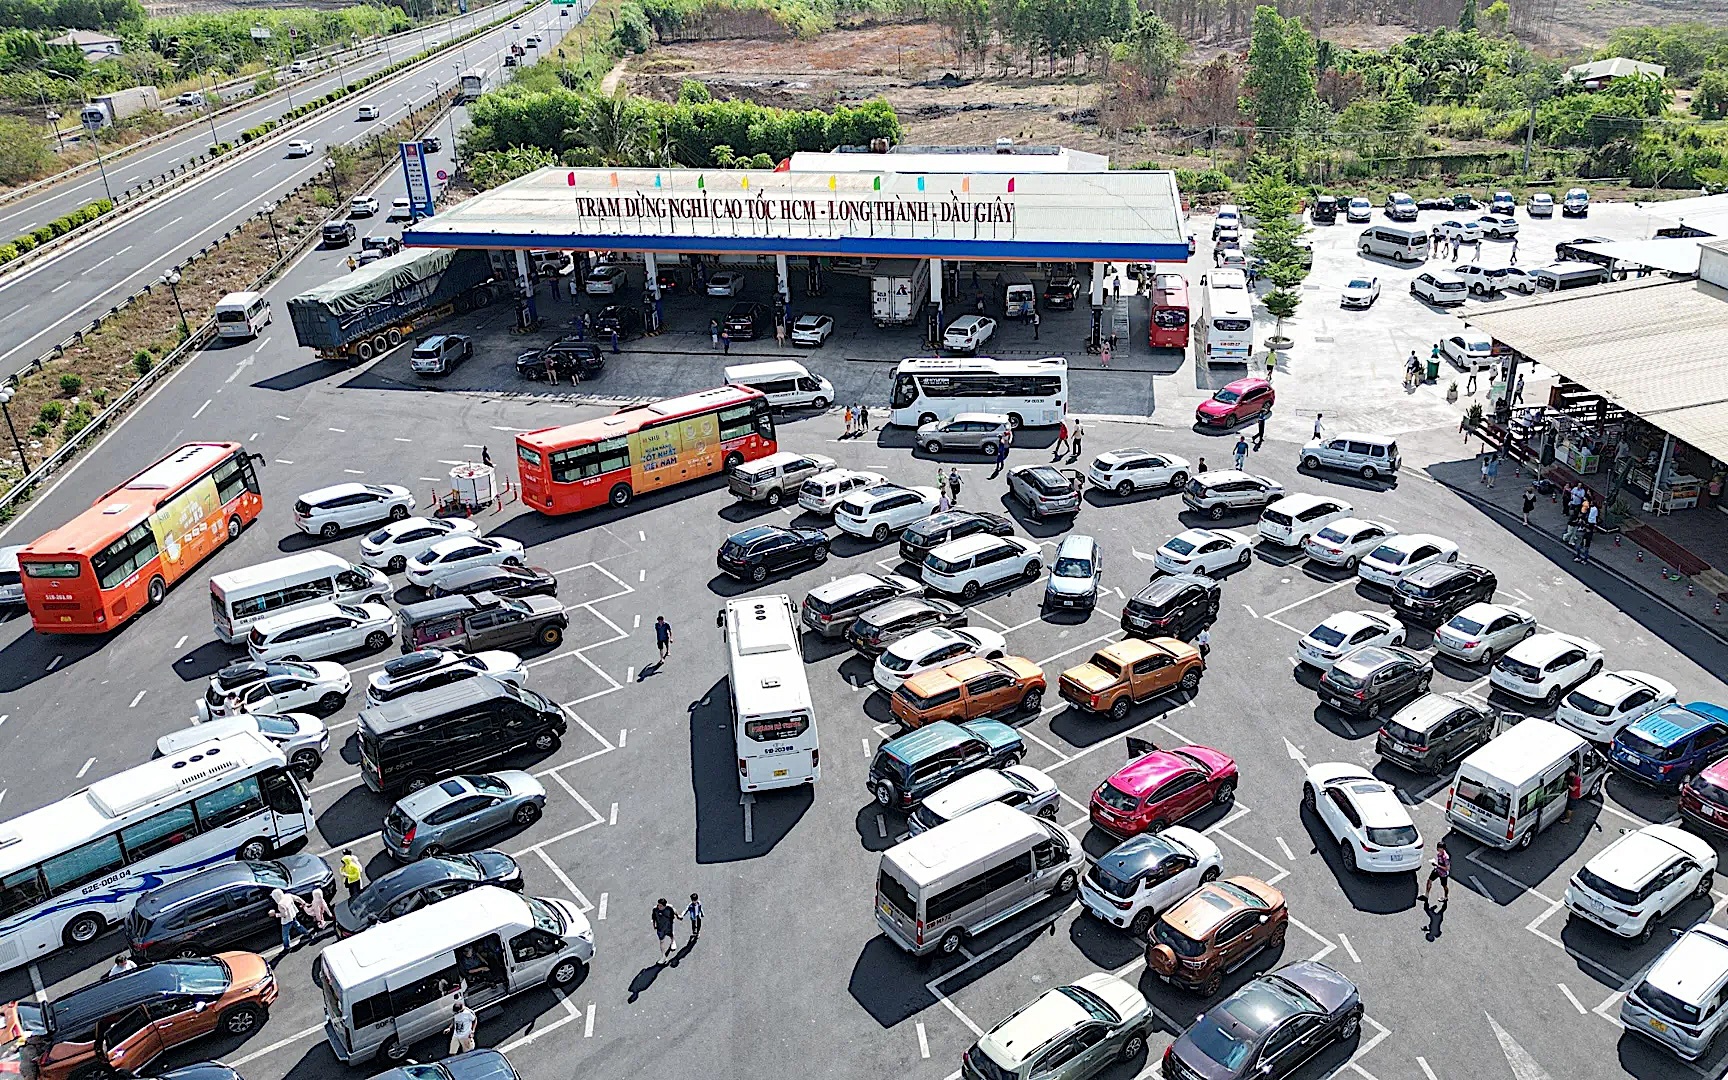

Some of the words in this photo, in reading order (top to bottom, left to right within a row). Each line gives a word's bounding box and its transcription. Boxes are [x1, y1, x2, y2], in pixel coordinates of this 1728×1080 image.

[576, 197, 620, 220] TRẠM
[624, 190, 667, 218] DỪNG
[669, 189, 709, 218] NGHỈ
[712, 198, 742, 219] CAO
[745, 188, 776, 219] TỐC
[780, 200, 816, 220] HCM
[829, 200, 870, 221] LONG
[873, 194, 929, 222] THÀNH
[940, 190, 971, 223] DẦU
[974, 195, 1015, 223] GIÂY
[660, 457, 677, 468] NAM
